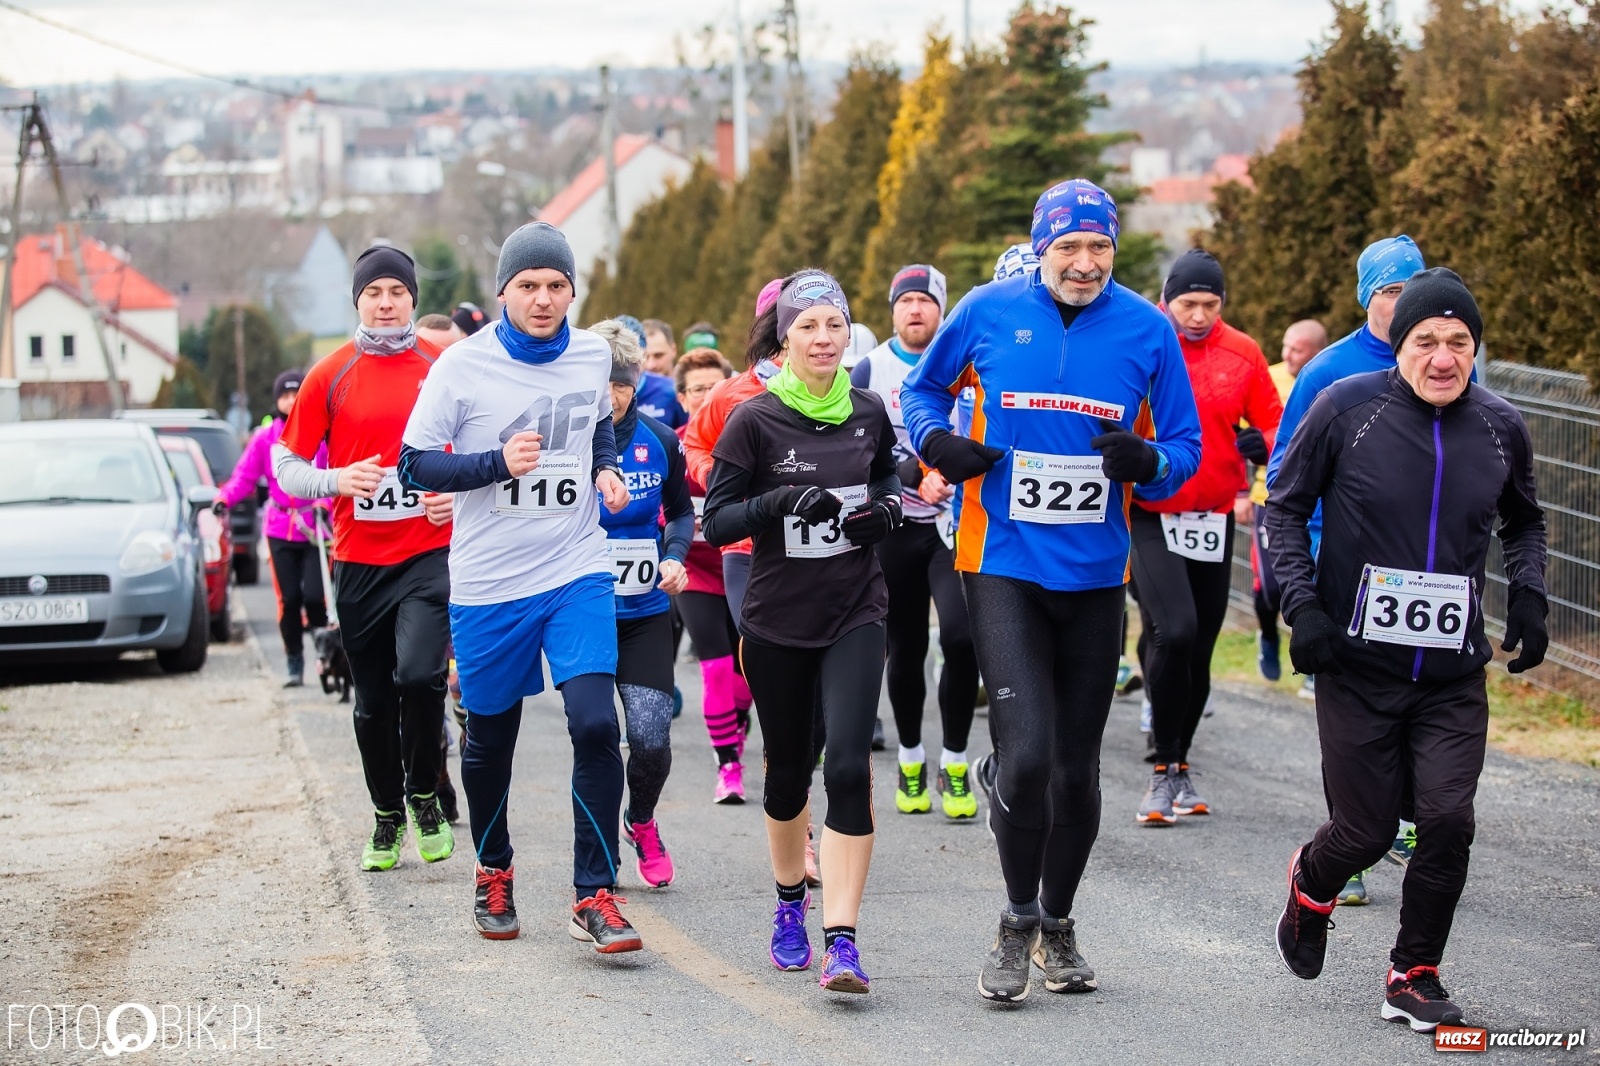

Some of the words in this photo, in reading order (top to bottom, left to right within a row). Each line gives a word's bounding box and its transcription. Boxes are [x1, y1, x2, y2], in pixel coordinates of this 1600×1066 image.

[1028, 398, 1121, 419] HELUKABEL
[620, 471, 662, 490] ERS
[503, 478, 577, 507] 116
[630, 491, 648, 501] EAM
[1017, 477, 1103, 511] 322
[792, 517, 841, 546] 13
[1168, 527, 1220, 552] 159
[1407, 579, 1466, 592] www.personalbest.pl
[1, 601, 38, 621] SZO
[1372, 594, 1463, 635] 366
